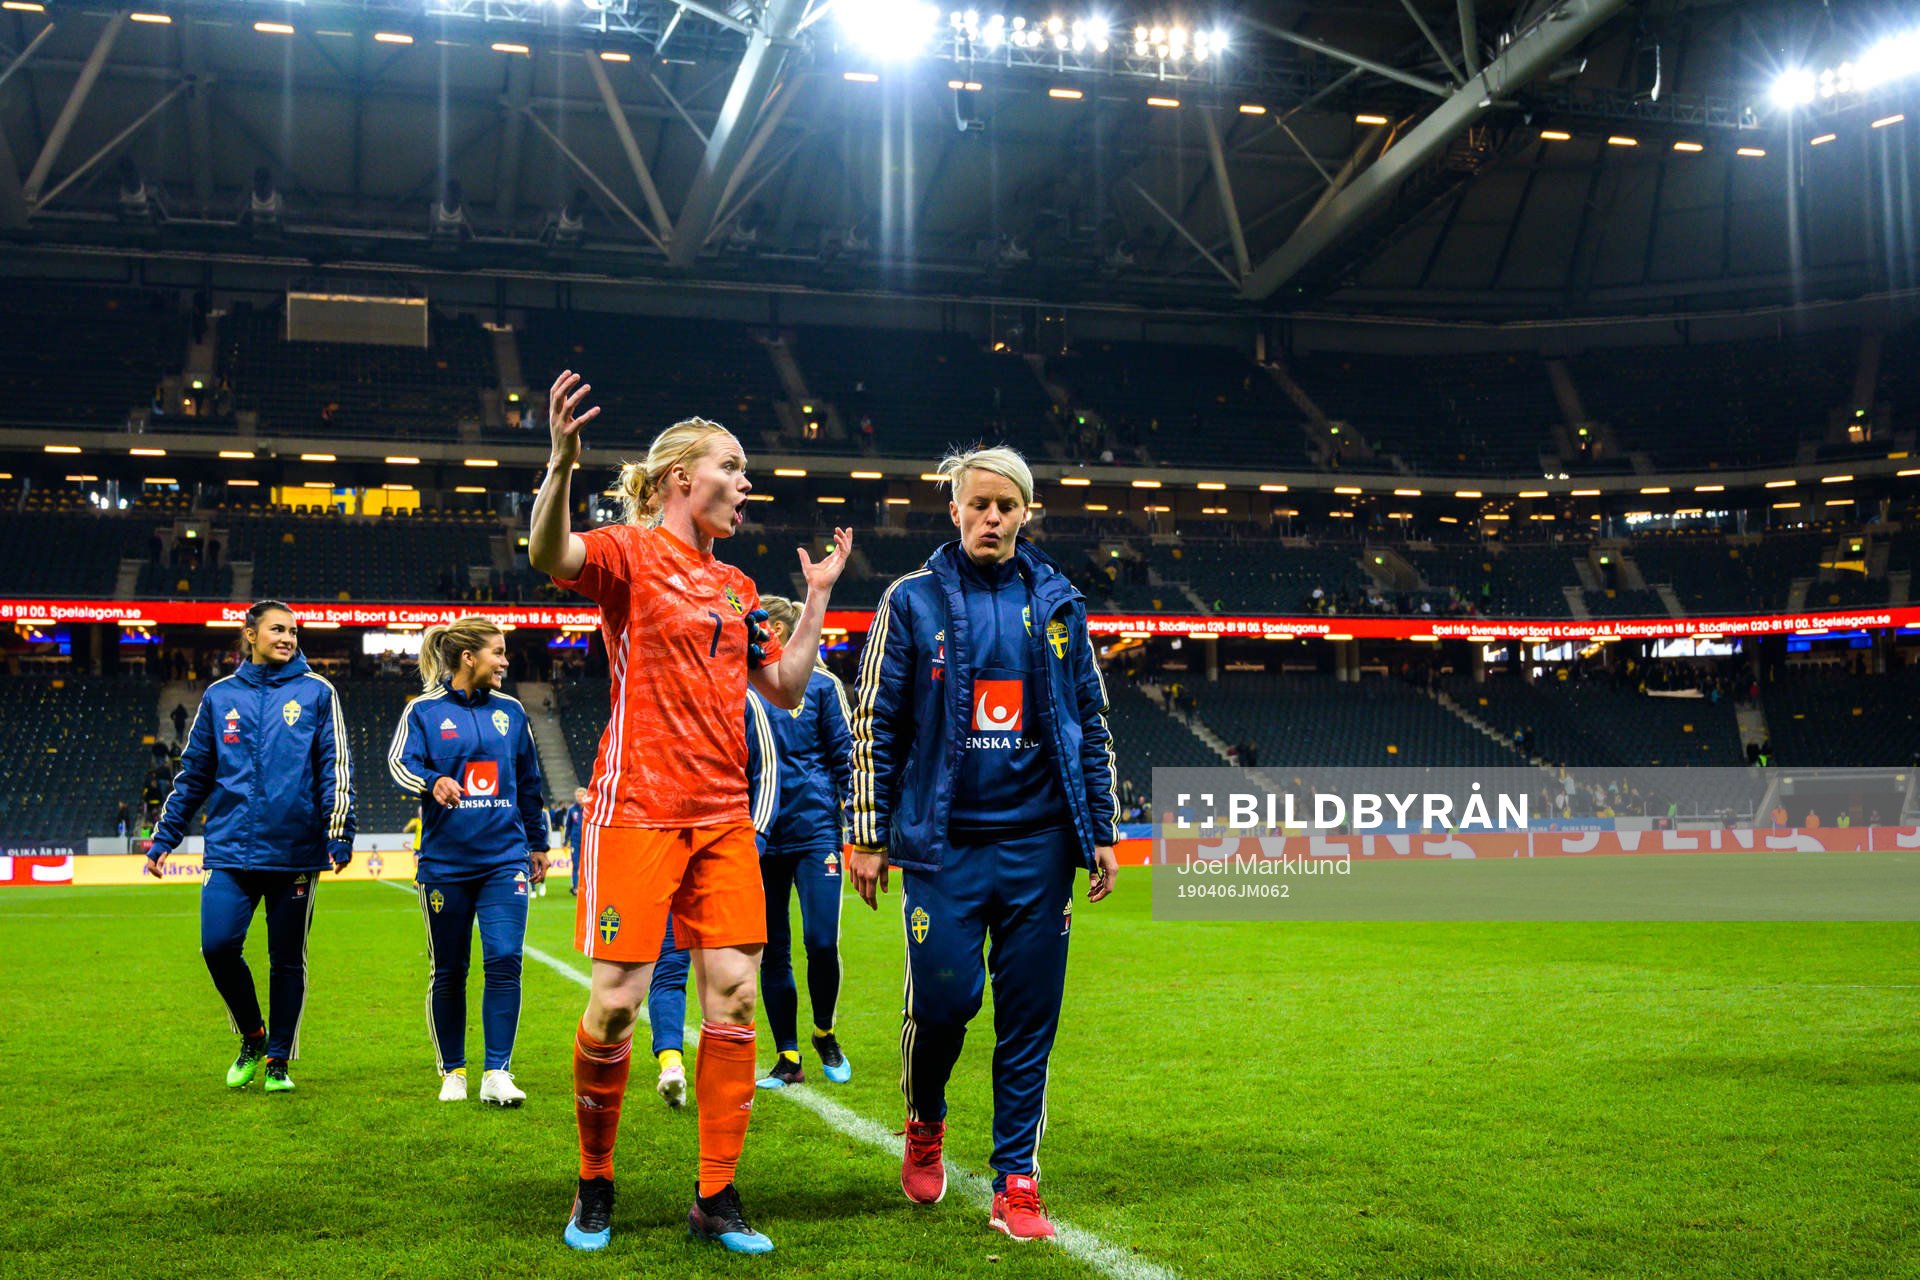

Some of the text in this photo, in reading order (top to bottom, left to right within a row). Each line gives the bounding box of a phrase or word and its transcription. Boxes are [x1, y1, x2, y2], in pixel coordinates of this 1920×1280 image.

[16, 605, 27, 618] 91
[30, 605, 48, 618] 00.
[50, 605, 141, 620] Spelalagom.se
[326, 610, 352, 622] Spel
[354, 610, 386, 623] Sport
[388, 610, 397, 622] &
[399, 610, 438, 622] Casino
[529, 612, 540, 624] 18
[541, 611, 554, 624] år.
[555, 612, 602, 626] Stödlinje
[1087, 620, 1135, 634] dersgräns
[1136, 620, 1145, 632] 18
[1158, 621, 1206, 633] Stödlinjen
[1207, 621, 1236, 633] 020-81
[1237, 621, 1247, 633] 91
[1262, 621, 1330, 635] Spelalagom.se
[1432, 625, 1453, 636] Spel
[1454, 624, 1471, 636] från
[1471, 624, 1507, 636] Svenska
[1508, 625, 1528, 637] Spel
[1529, 626, 1553, 637] Sport
[1562, 625, 1595, 637] Casino
[1613, 622, 1674, 637] Åldersgräns
[1675, 623, 1684, 634] 18
[1699, 621, 1749, 634] Stödlinjen
[1750, 619, 1782, 632] 020-81
[1783, 618, 1794, 630] 91
[1812, 614, 1891, 628] Spelalagom.se
[931, 667, 945, 680] IC
[965, 737, 1012, 749] ENSKA
